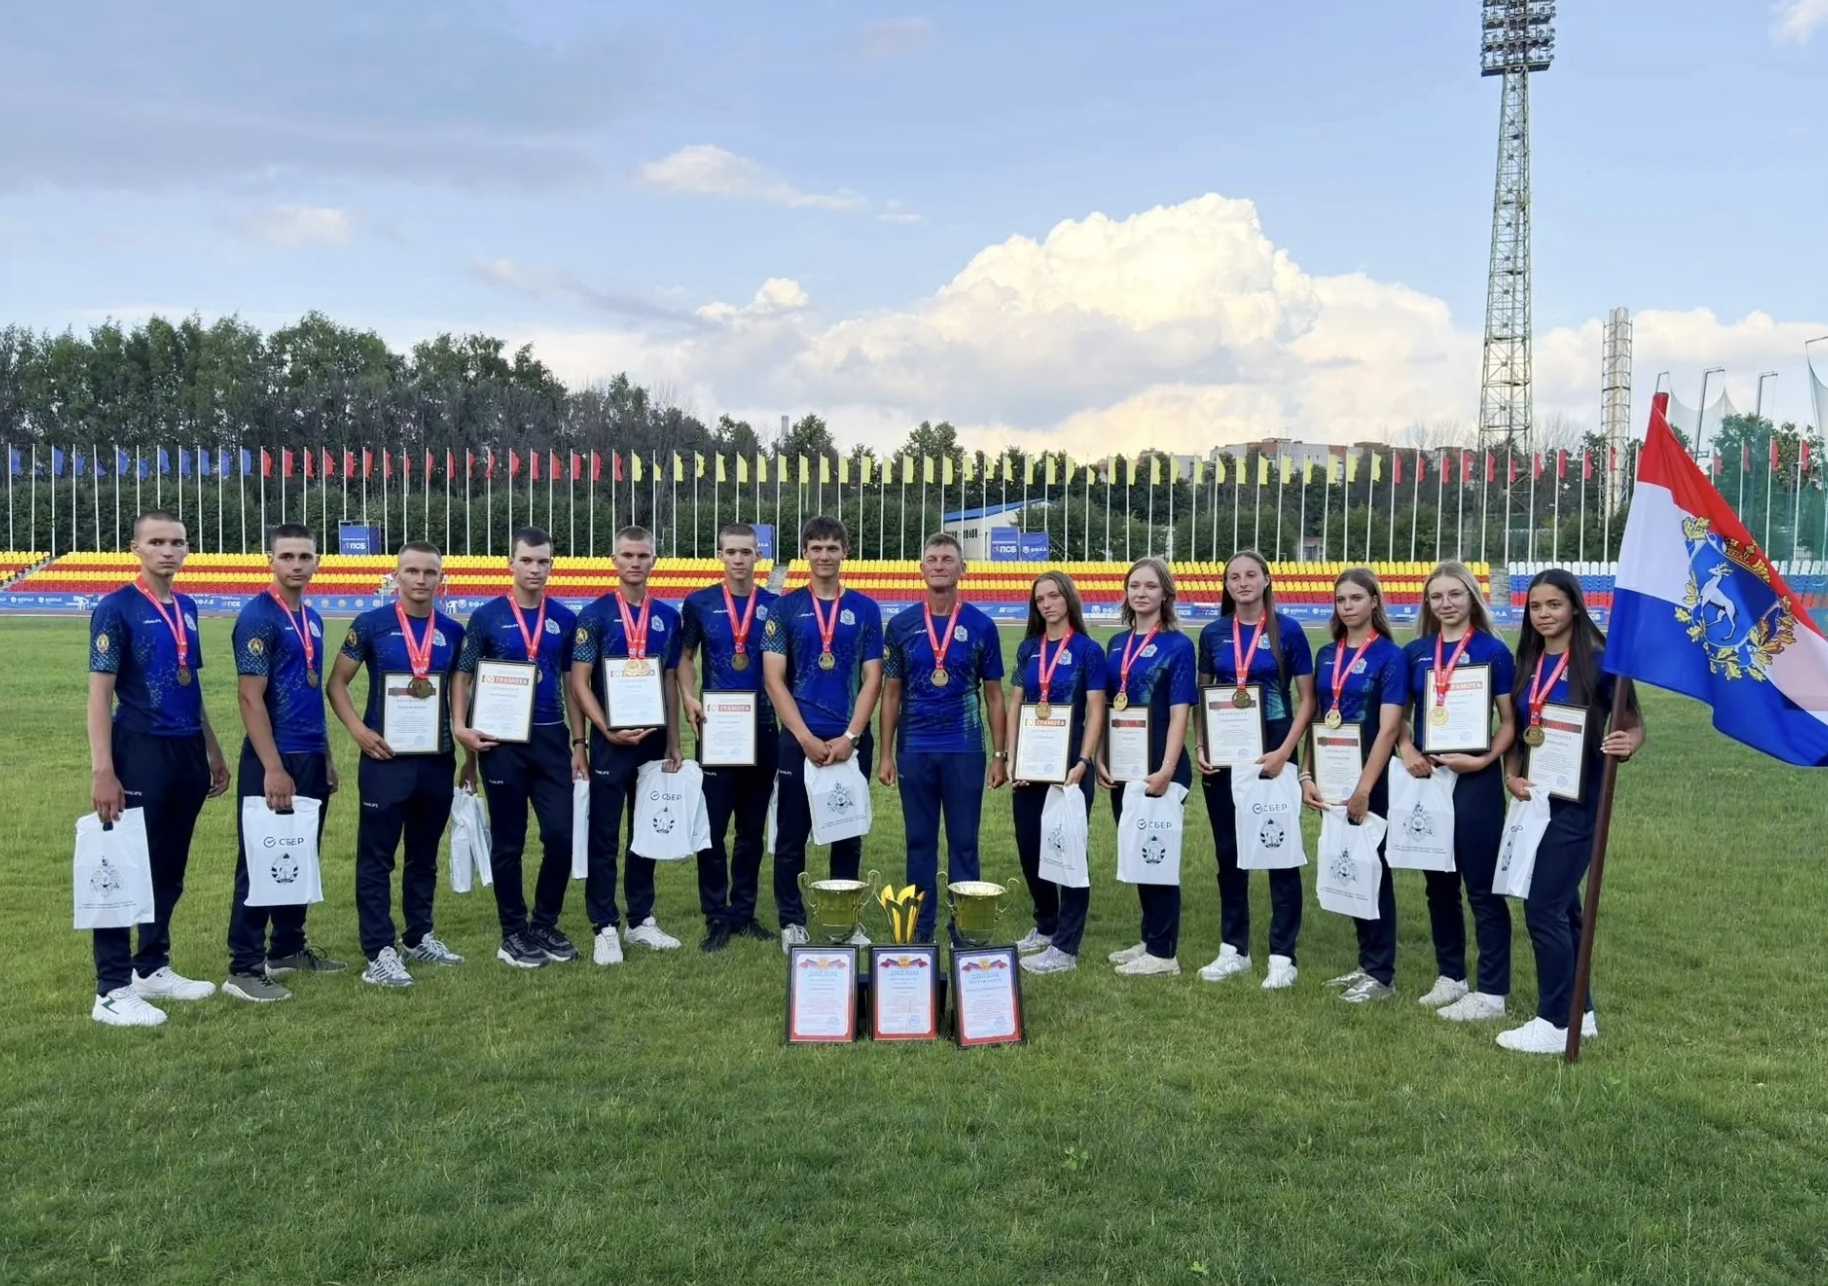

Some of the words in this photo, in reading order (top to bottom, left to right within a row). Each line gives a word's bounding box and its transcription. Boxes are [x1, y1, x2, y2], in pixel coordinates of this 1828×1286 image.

[350, 542, 366, 550] ПСБ
[1000, 545, 1017, 553] ПСБ
[495, 677, 528, 685] ГРАМОТА
[661, 793, 683, 801] СБЕР
[1263, 803, 1288, 812] СБЕР
[1148, 820, 1173, 829] СБЕР
[278, 837, 305, 847] СБЕР
